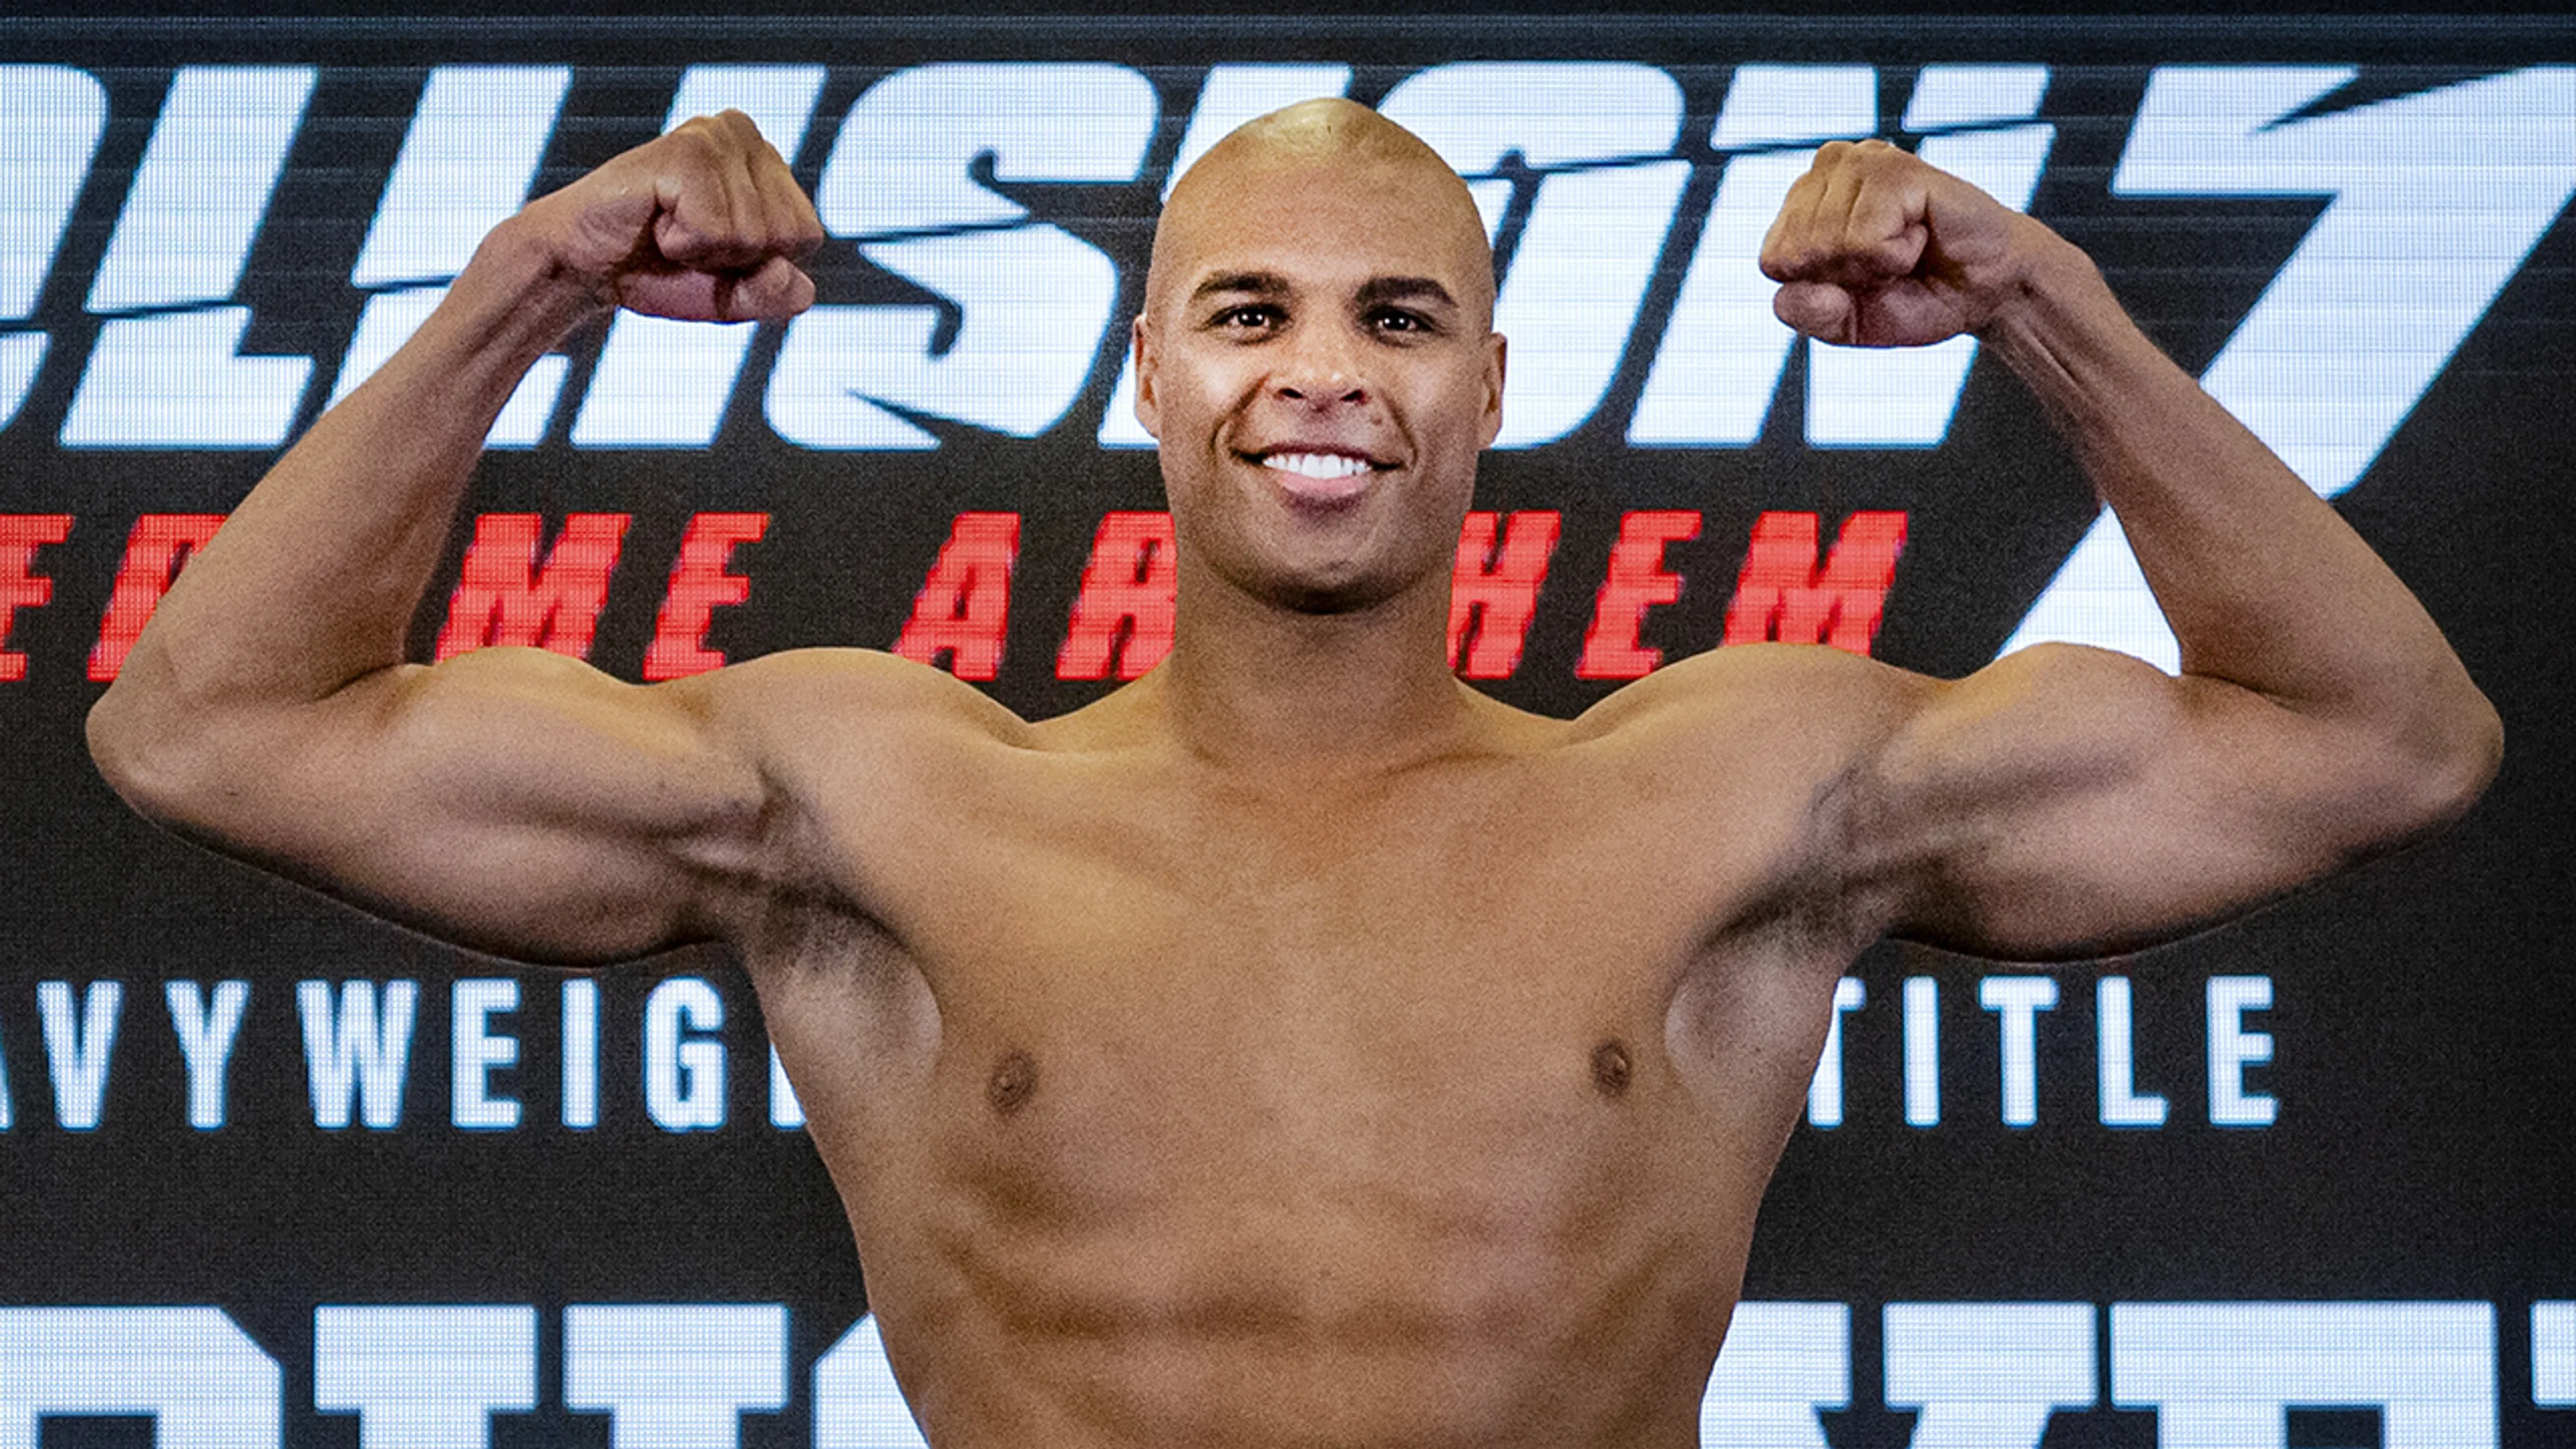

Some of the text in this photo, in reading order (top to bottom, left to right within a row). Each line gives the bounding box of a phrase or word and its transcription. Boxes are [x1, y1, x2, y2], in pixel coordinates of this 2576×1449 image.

[1996, 63, 2576, 678] 7
[891, 511, 1909, 681] ARHEM
[0, 977, 807, 1131] VYWEIG
